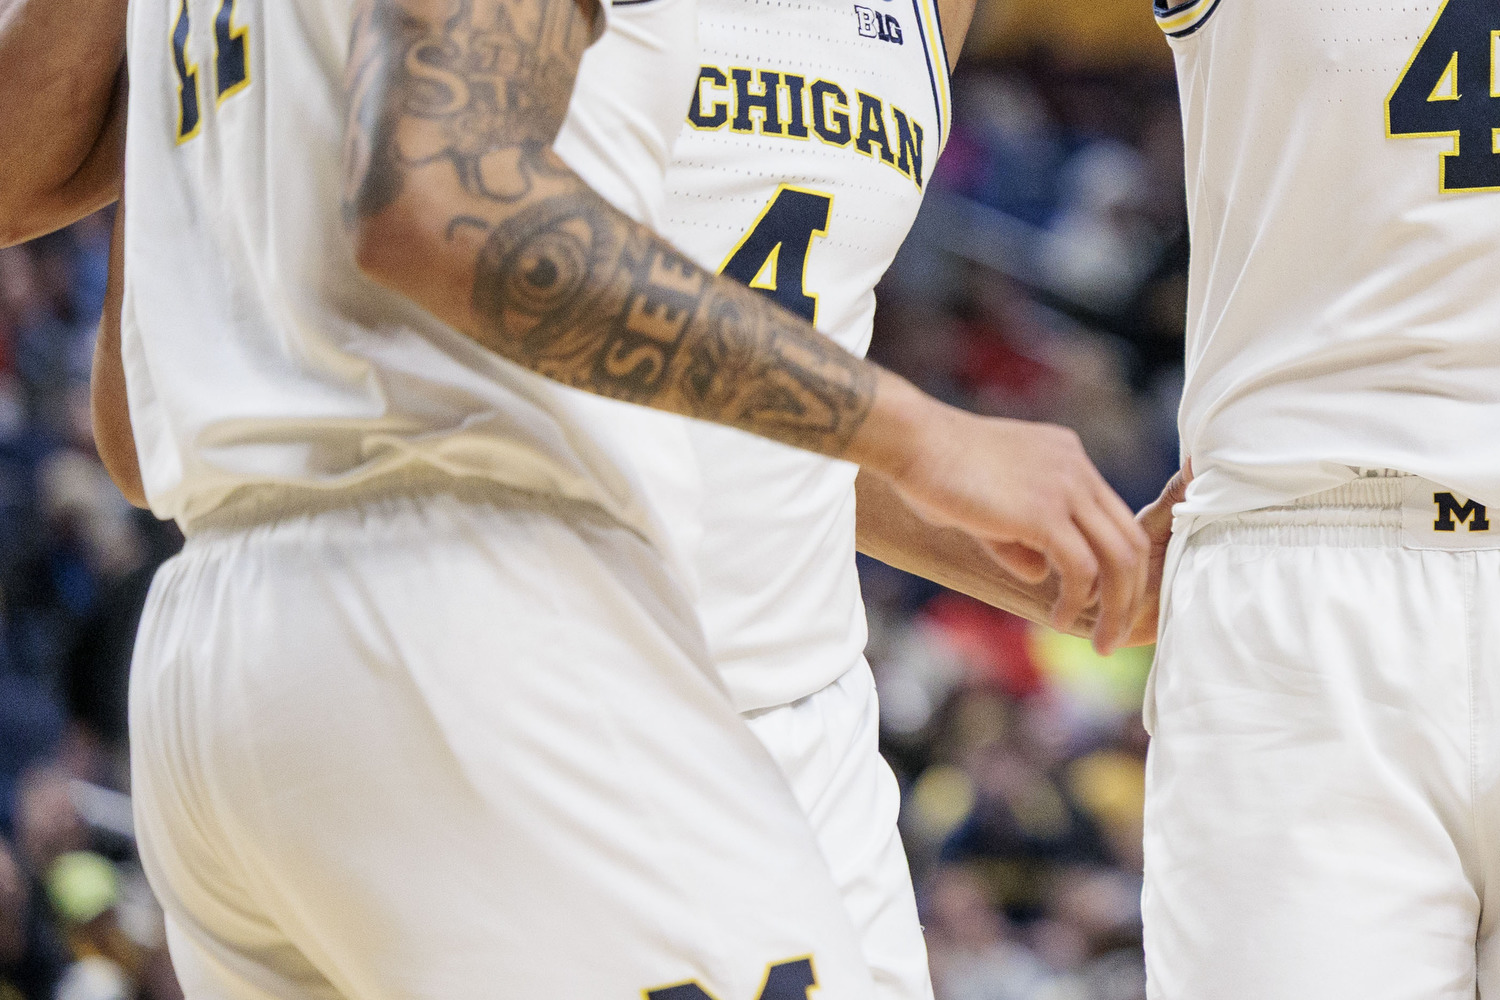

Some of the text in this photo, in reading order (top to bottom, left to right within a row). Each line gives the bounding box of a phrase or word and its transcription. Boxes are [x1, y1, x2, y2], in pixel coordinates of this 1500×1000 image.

[685, 64, 923, 195] CHIGAN
[602, 251, 701, 384] SEE
[714, 182, 835, 330] 4
[1433, 491, 1490, 532] M
